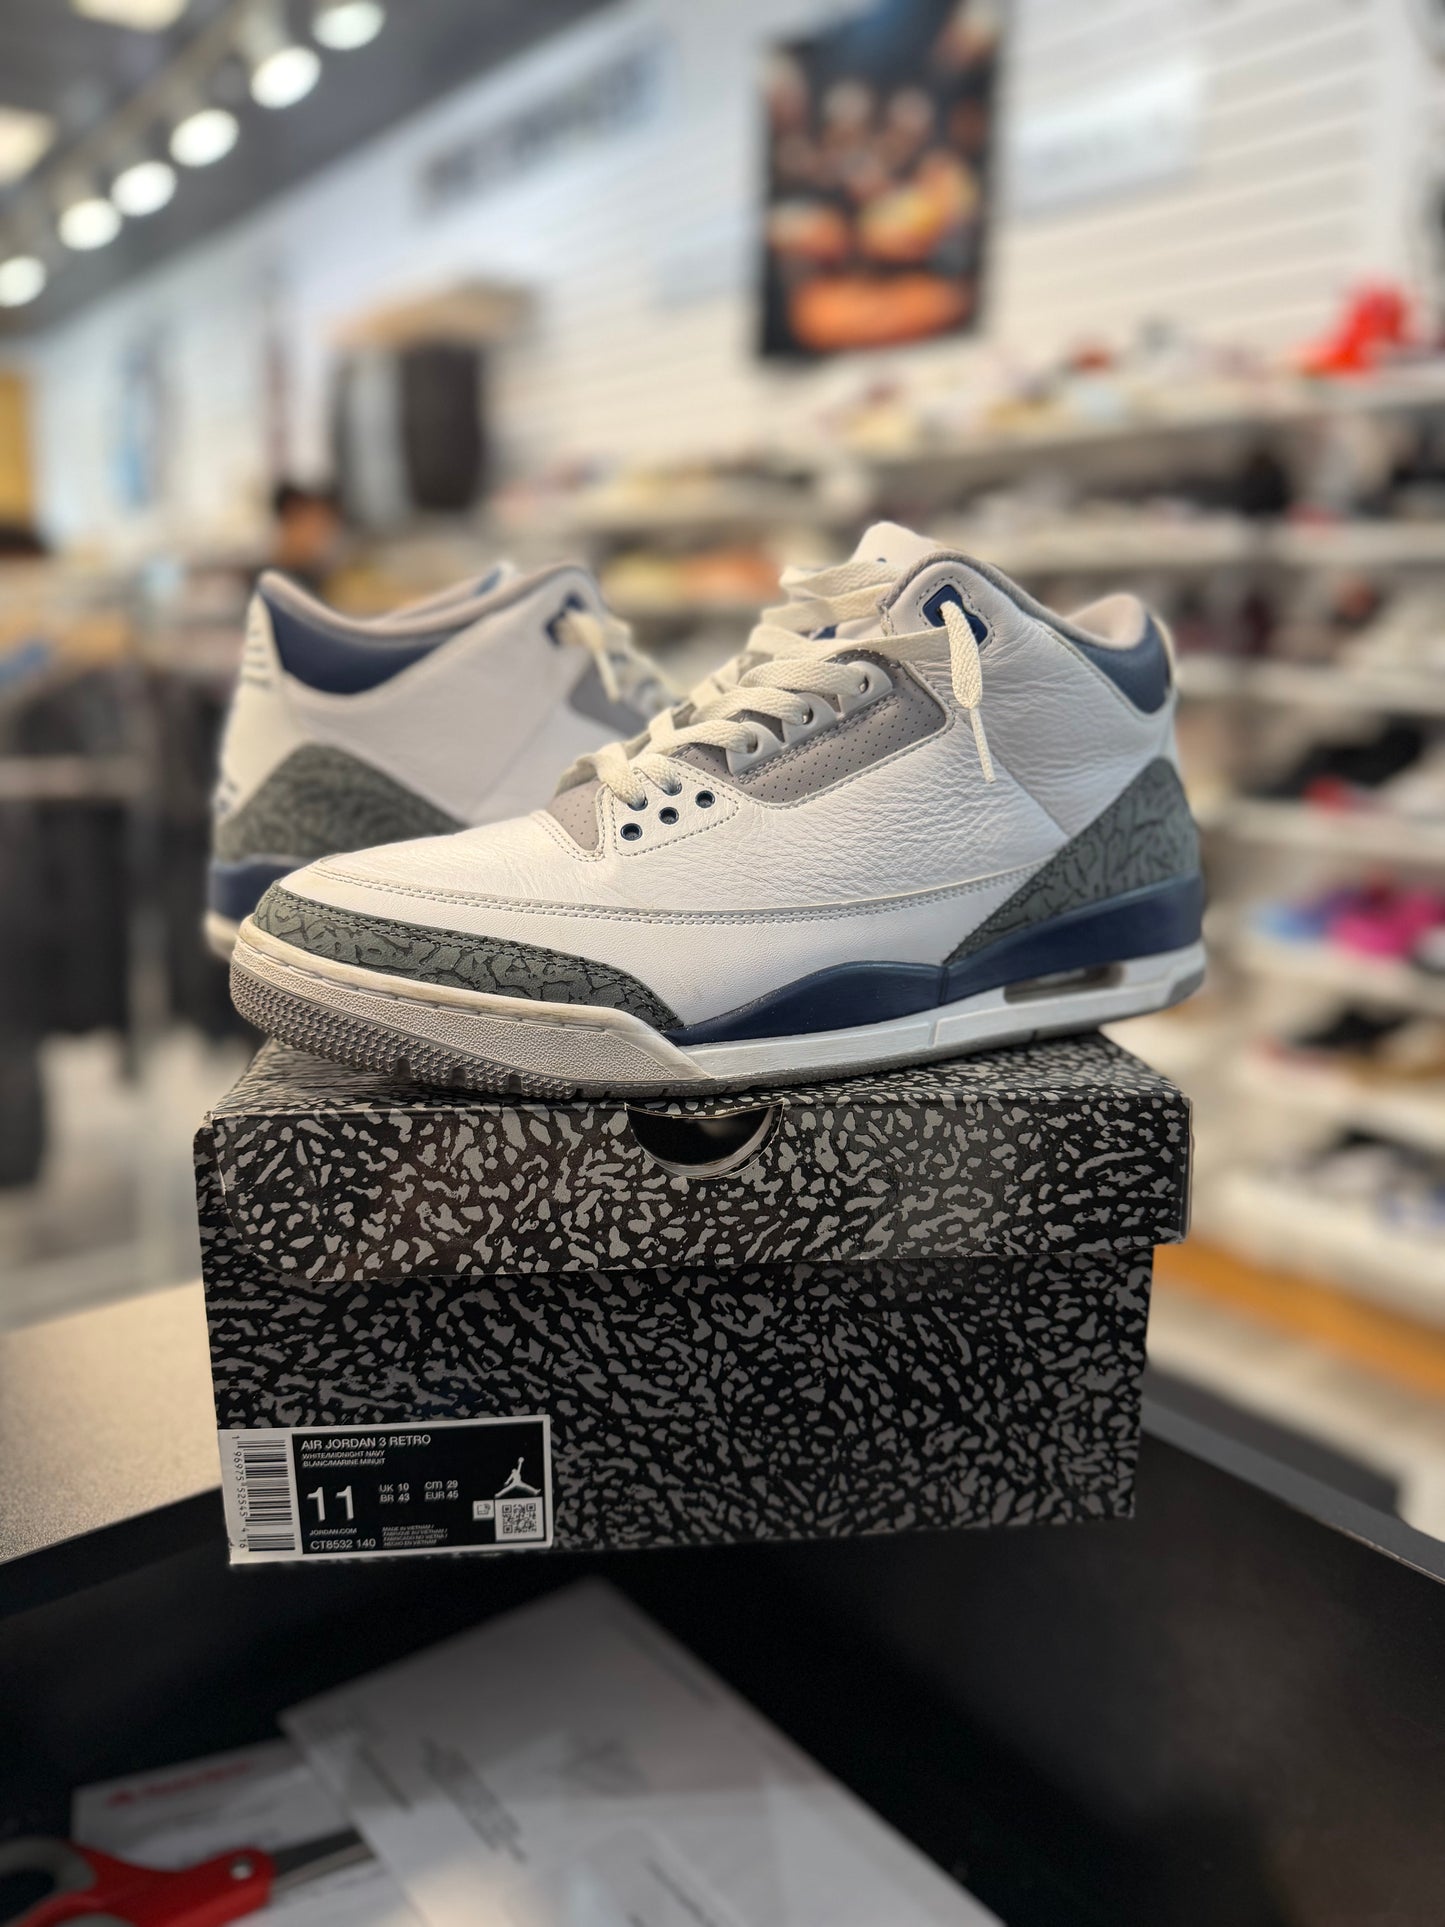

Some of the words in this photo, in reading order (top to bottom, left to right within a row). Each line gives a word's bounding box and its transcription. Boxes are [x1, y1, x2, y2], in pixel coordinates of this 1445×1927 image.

[301, 1440, 322, 1450] AIR
[325, 1436, 376, 1450] JORDAN
[378, 1436, 387, 1447] 3
[389, 1434, 432, 1446] RETRO
[365, 1450, 386, 1458] NAVY
[233, 1451, 244, 1482] 96975
[378, 1484, 394, 1492] UK
[397, 1482, 410, 1491] 10
[446, 1480, 458, 1489] 29
[379, 1494, 394, 1503] BR
[398, 1493, 410, 1502] 43
[424, 1491, 445, 1500] EUR
[447, 1490, 459, 1500] 45
[306, 1485, 354, 1522] 11
[309, 1528, 358, 1536] JORDAN.COM
[310, 1539, 353, 1550] CT8532
[356, 1538, 376, 1549] 140
